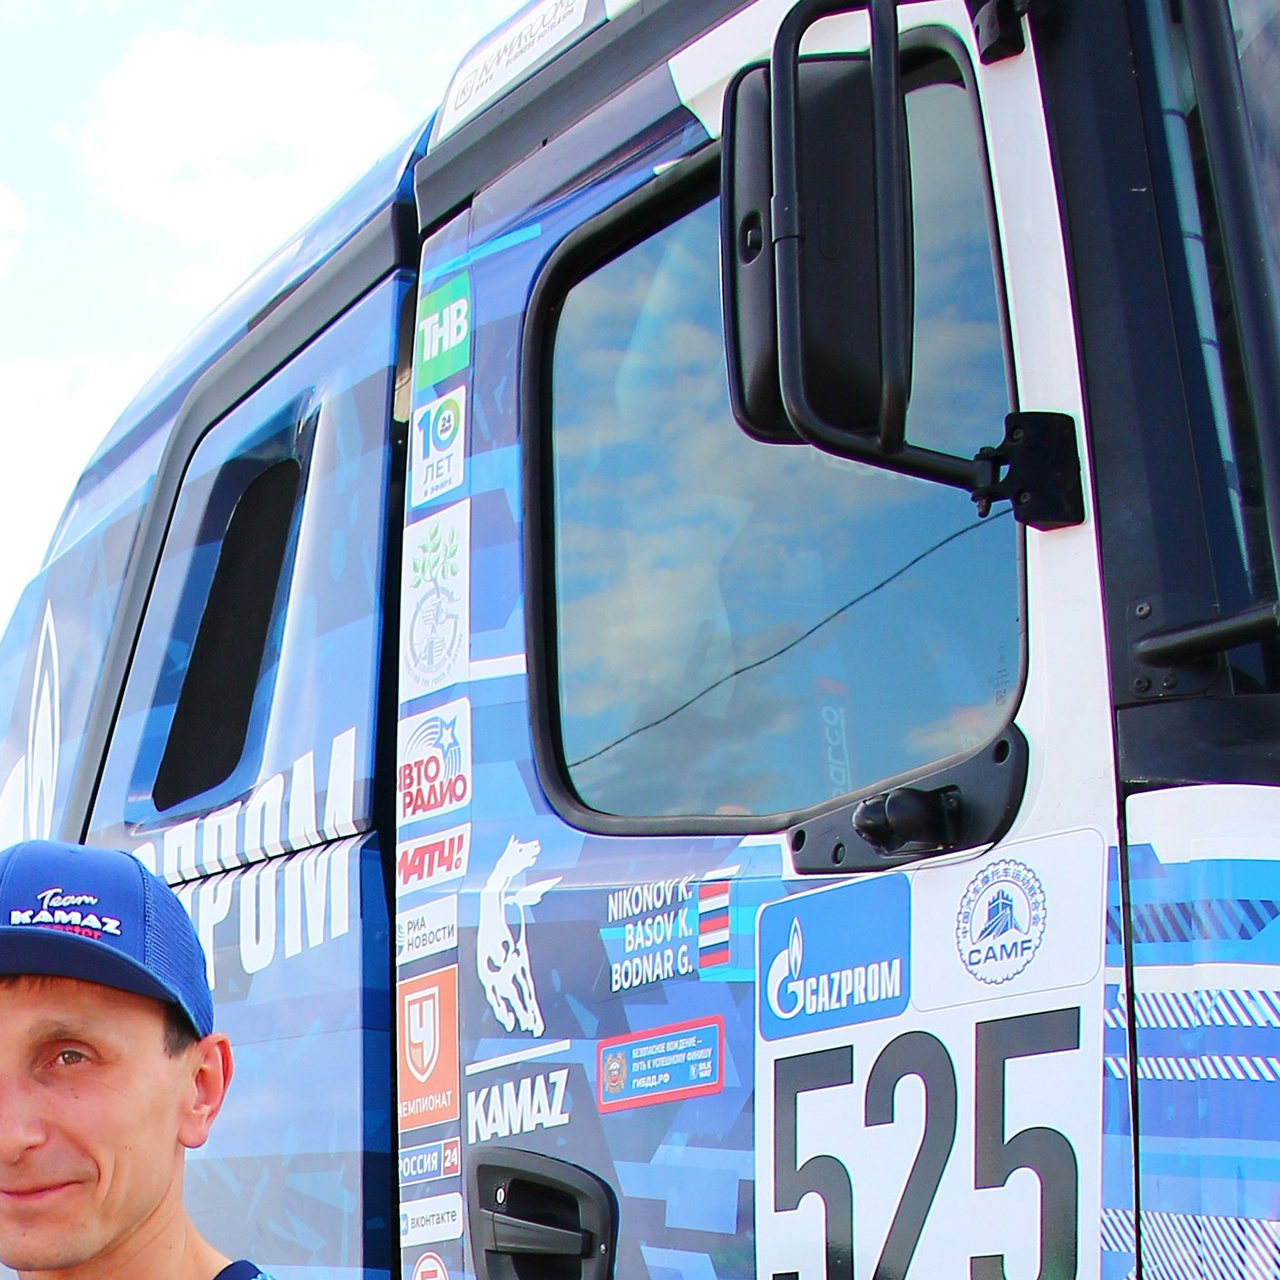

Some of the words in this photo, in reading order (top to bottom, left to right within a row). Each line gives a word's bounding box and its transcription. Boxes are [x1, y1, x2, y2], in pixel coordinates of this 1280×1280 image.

[423, 453, 454, 485] ЛЕТ
[403, 774, 468, 819] РАДИО
[37, 888, 99, 910] Team
[607, 878, 679, 923] NIKONOV
[678, 874, 696, 902] K.
[10, 910, 122, 936] KAMAZ
[407, 916, 426, 933] РИА
[407, 923, 455, 952] НОВОСТИ
[625, 910, 675, 953] BASOV
[678, 907, 693, 939] K.
[968, 939, 1033, 966] CAMF
[611, 948, 674, 992] BODNAR
[677, 944, 693, 975] G.
[805, 958, 901, 1015] GAZPROM
[632, 1073, 670, 1089] ГИБДД.РФ
[467, 1068, 570, 1145] KAMAZ
[445, 1147, 458, 1168] 24
[410, 1210, 457, 1229] вконтакте
